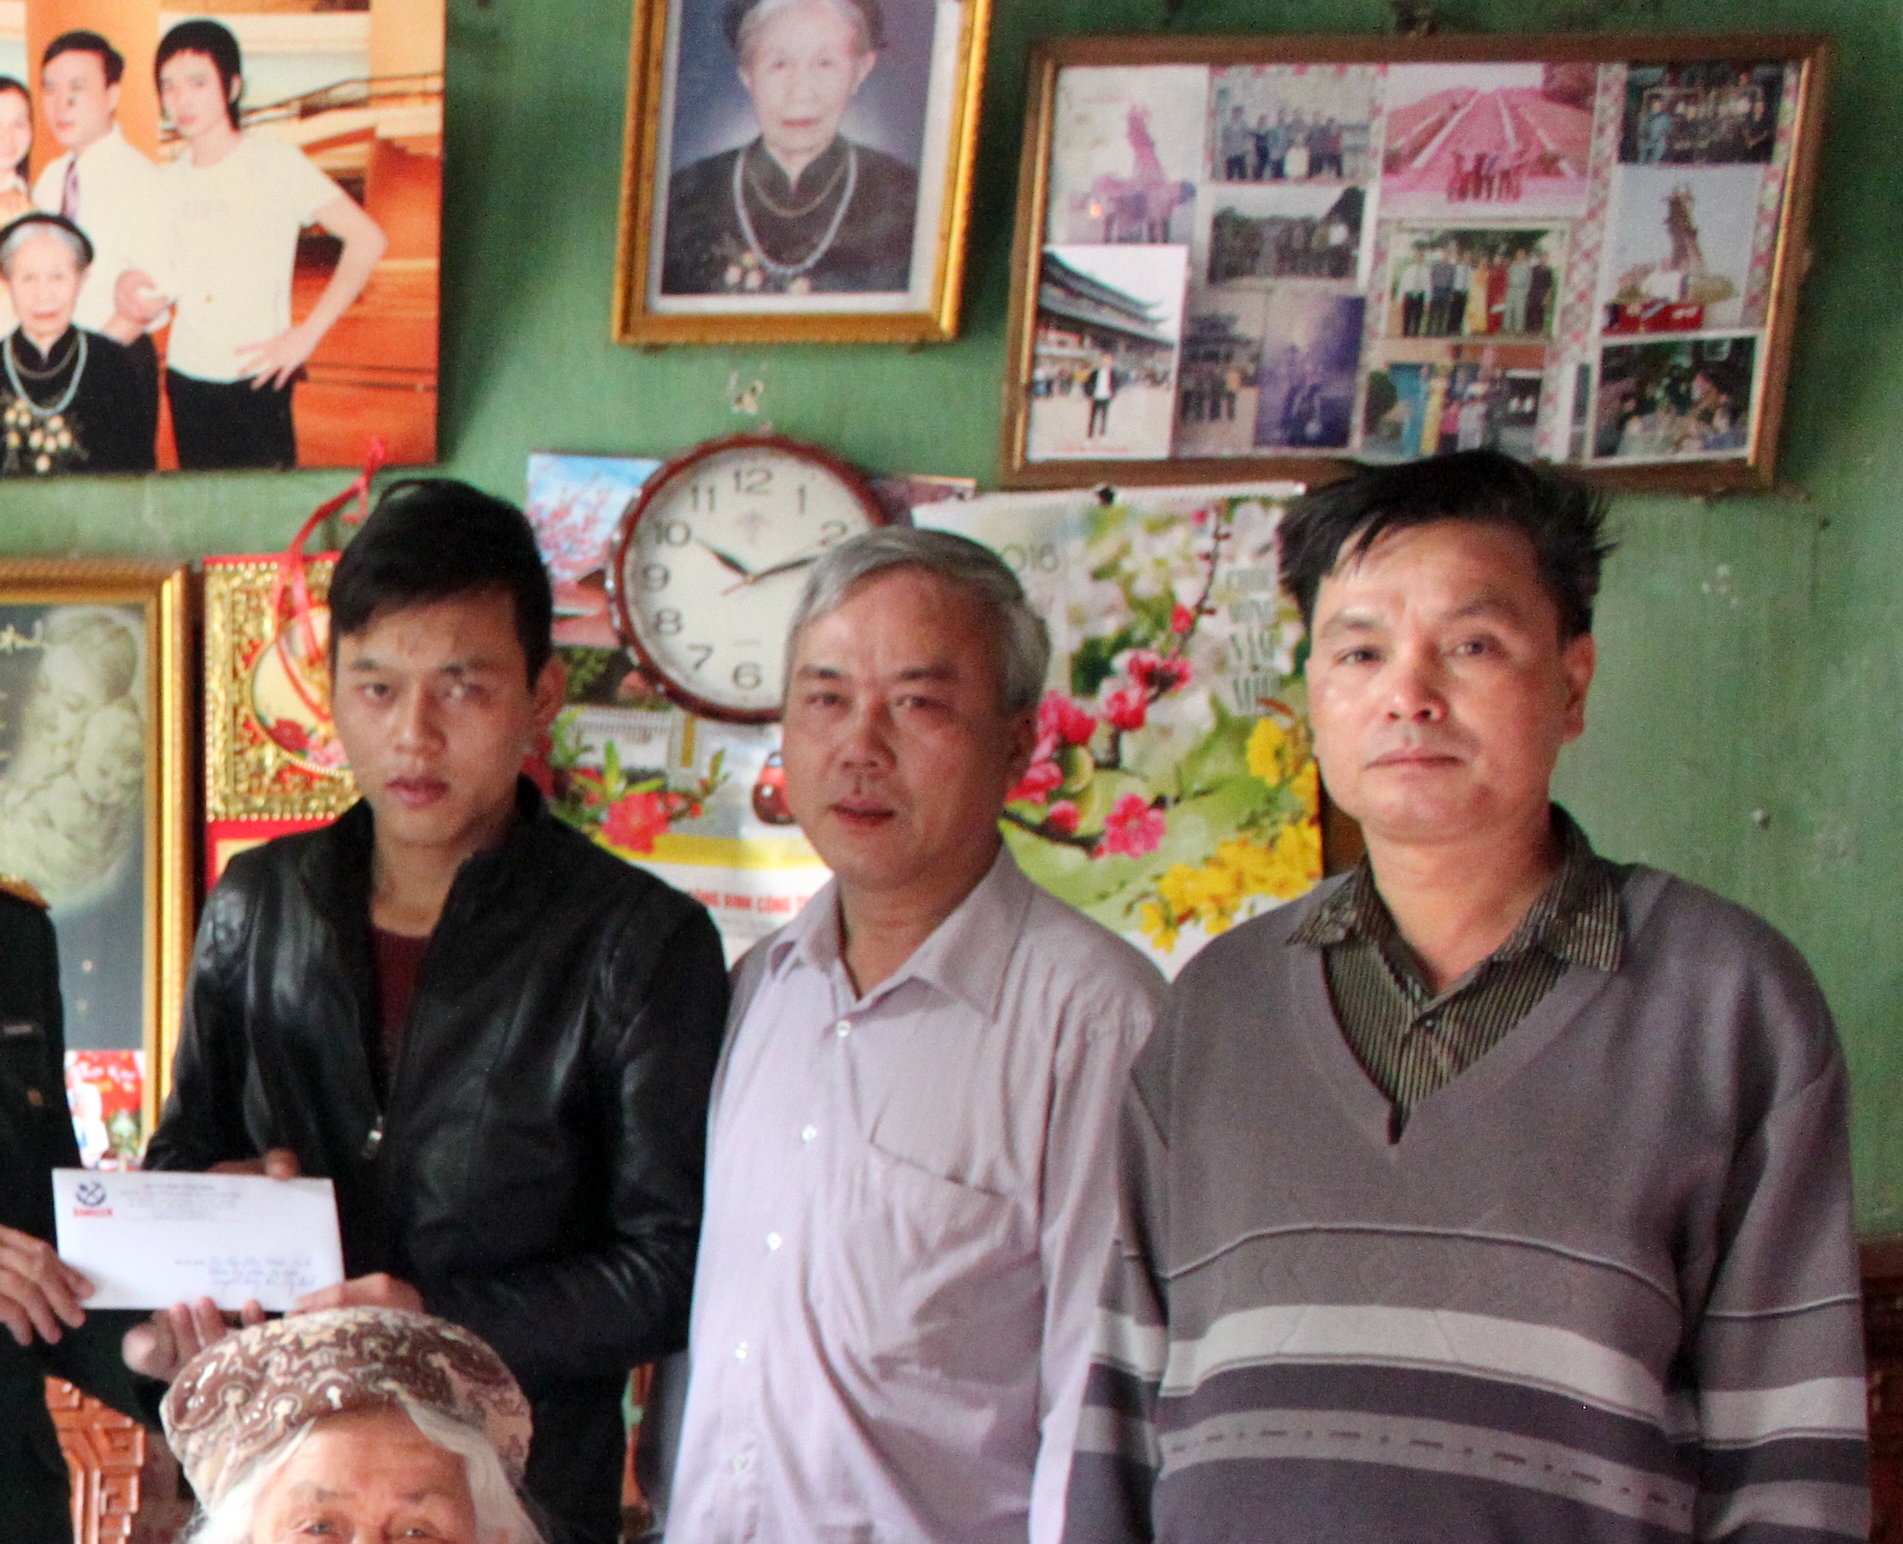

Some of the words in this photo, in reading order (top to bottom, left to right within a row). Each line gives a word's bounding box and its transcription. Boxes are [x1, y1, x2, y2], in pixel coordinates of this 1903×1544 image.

[733, 467, 773, 494] 12
[691, 484, 715, 513] 11
[797, 484, 806, 515] 1
[653, 519, 691, 548] 10
[820, 519, 848, 547] 2
[999, 543, 1059, 573] 016
[643, 563, 671, 592] 9
[654, 608, 683, 636] 8
[687, 644, 714, 671] 7
[732, 662, 762, 690] 6
